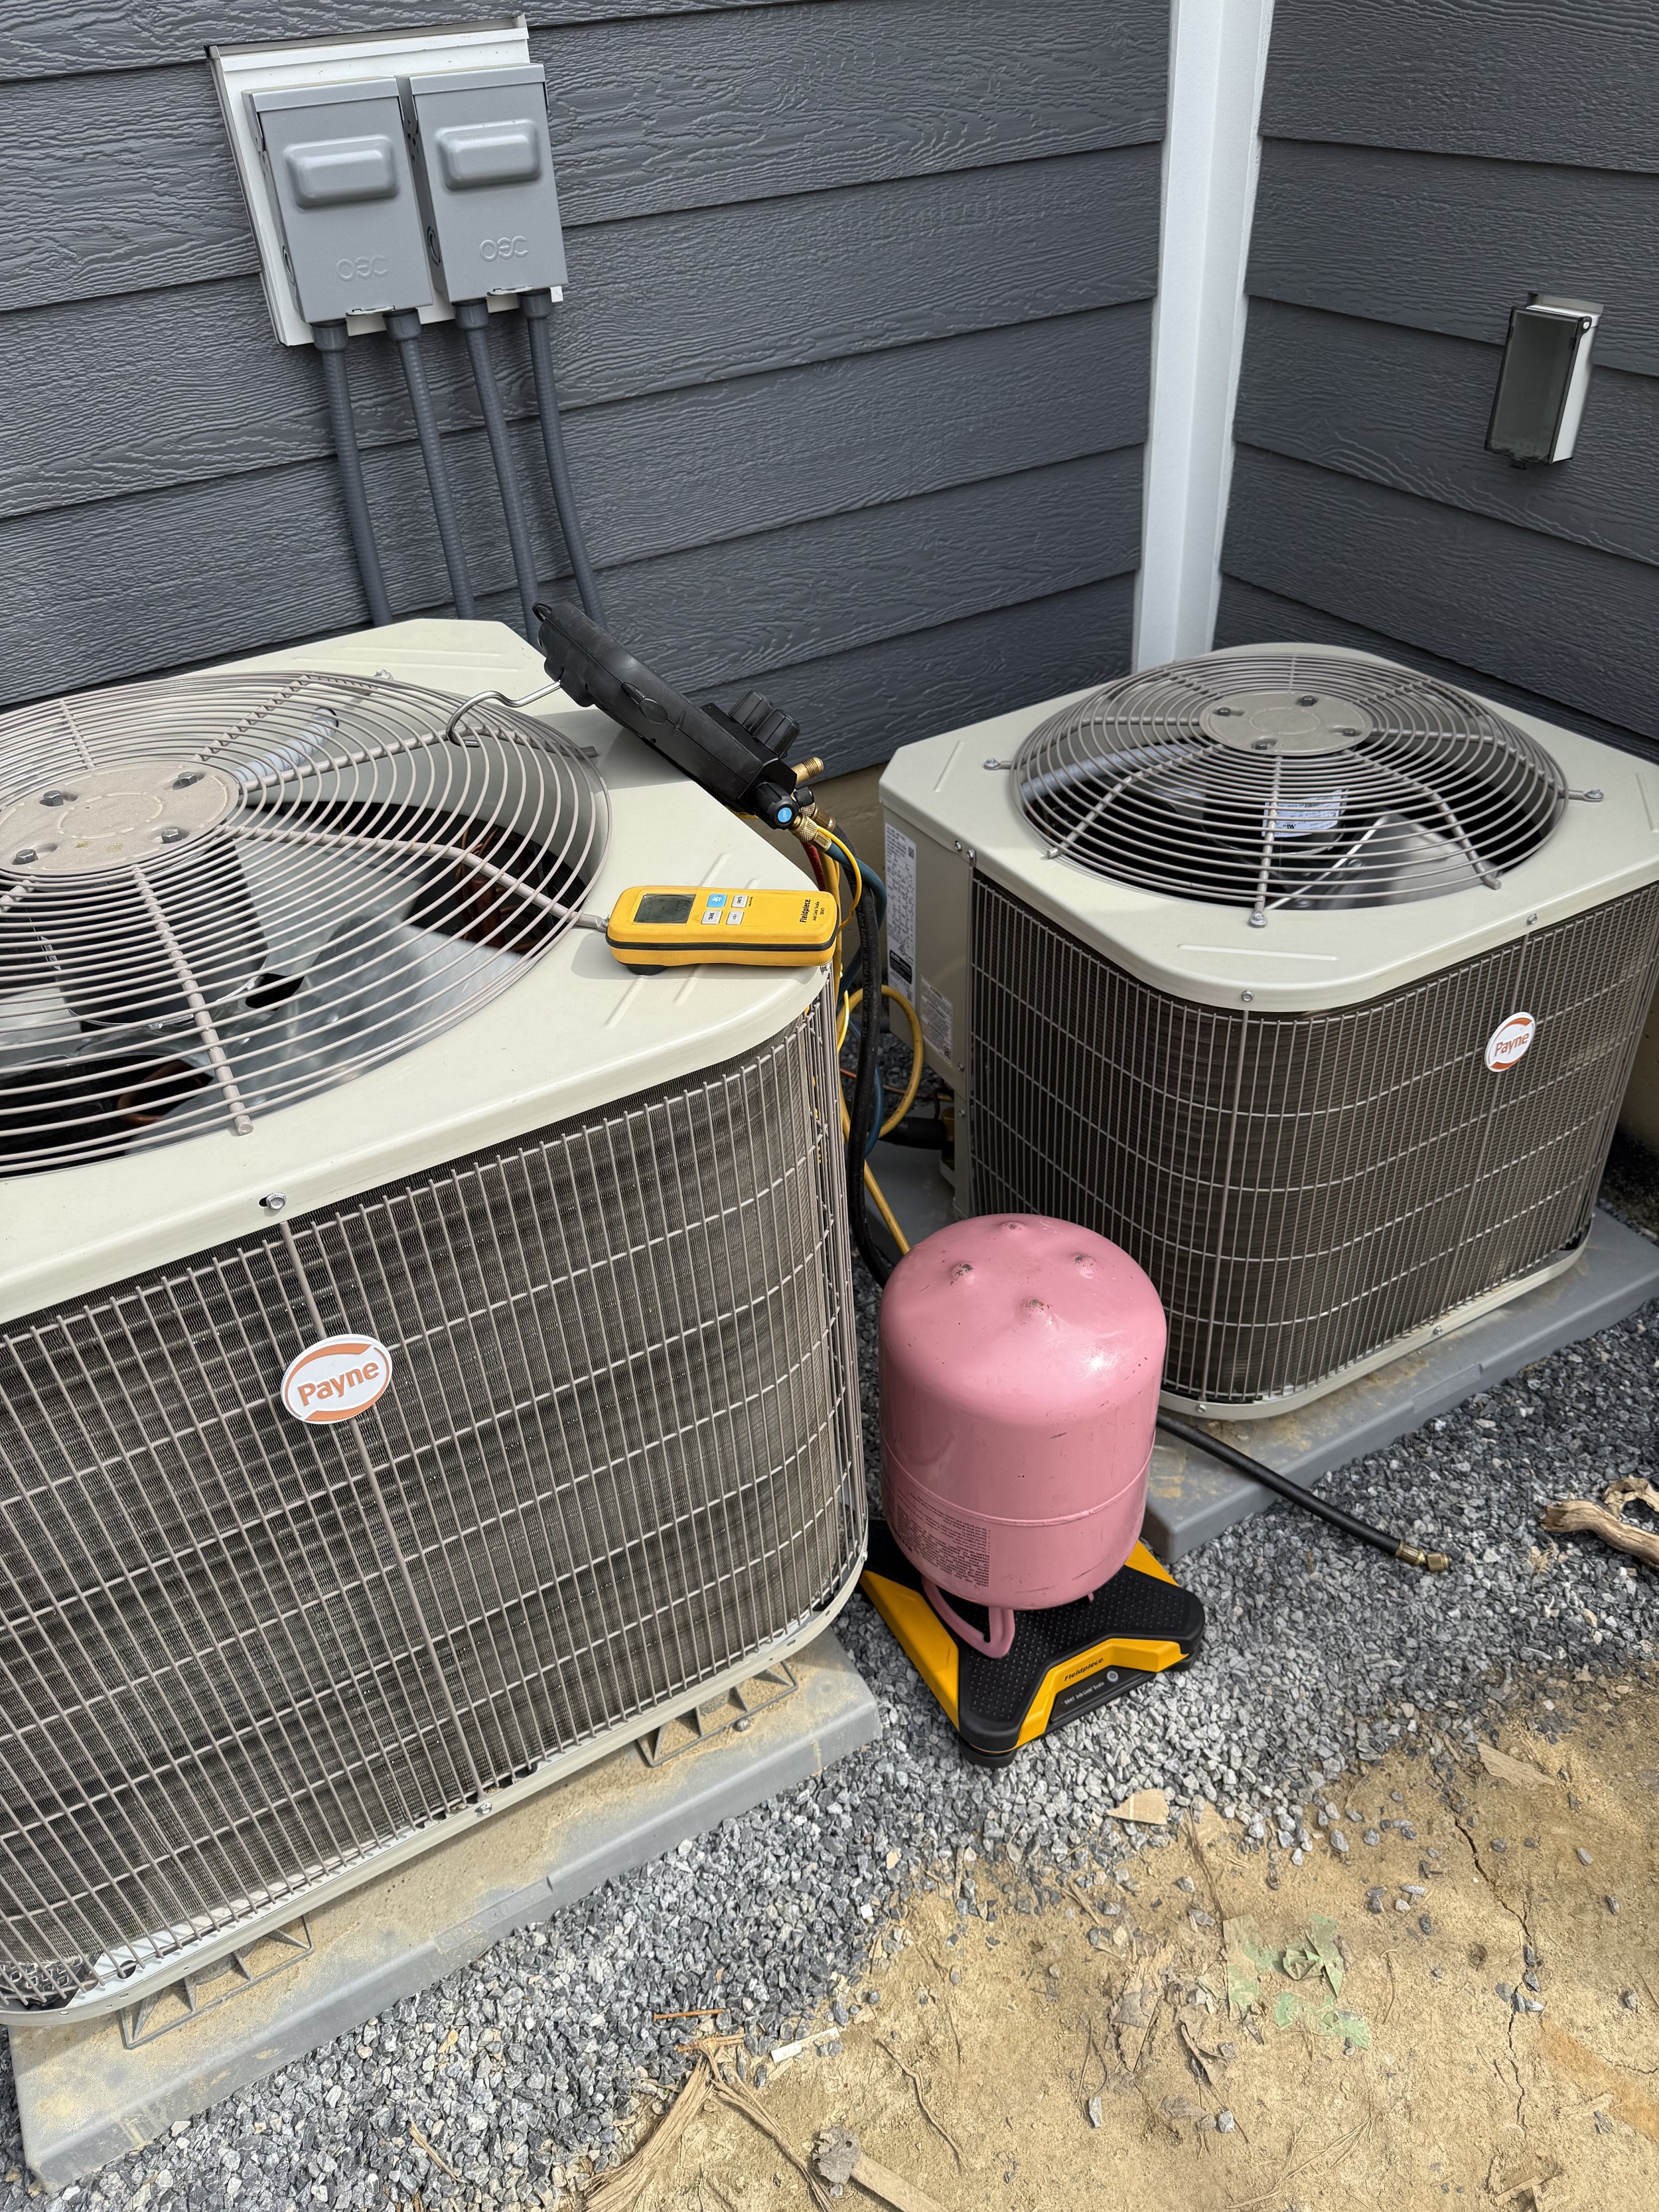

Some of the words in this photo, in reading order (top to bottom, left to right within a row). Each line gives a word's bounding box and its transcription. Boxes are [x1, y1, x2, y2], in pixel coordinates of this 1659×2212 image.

[799, 899, 811, 923] Fieldpiece
[1494, 1033, 1530, 1058] Payne
[297, 1361, 380, 1408] Payne
[1064, 1658, 1103, 1681] Fieldpiece
